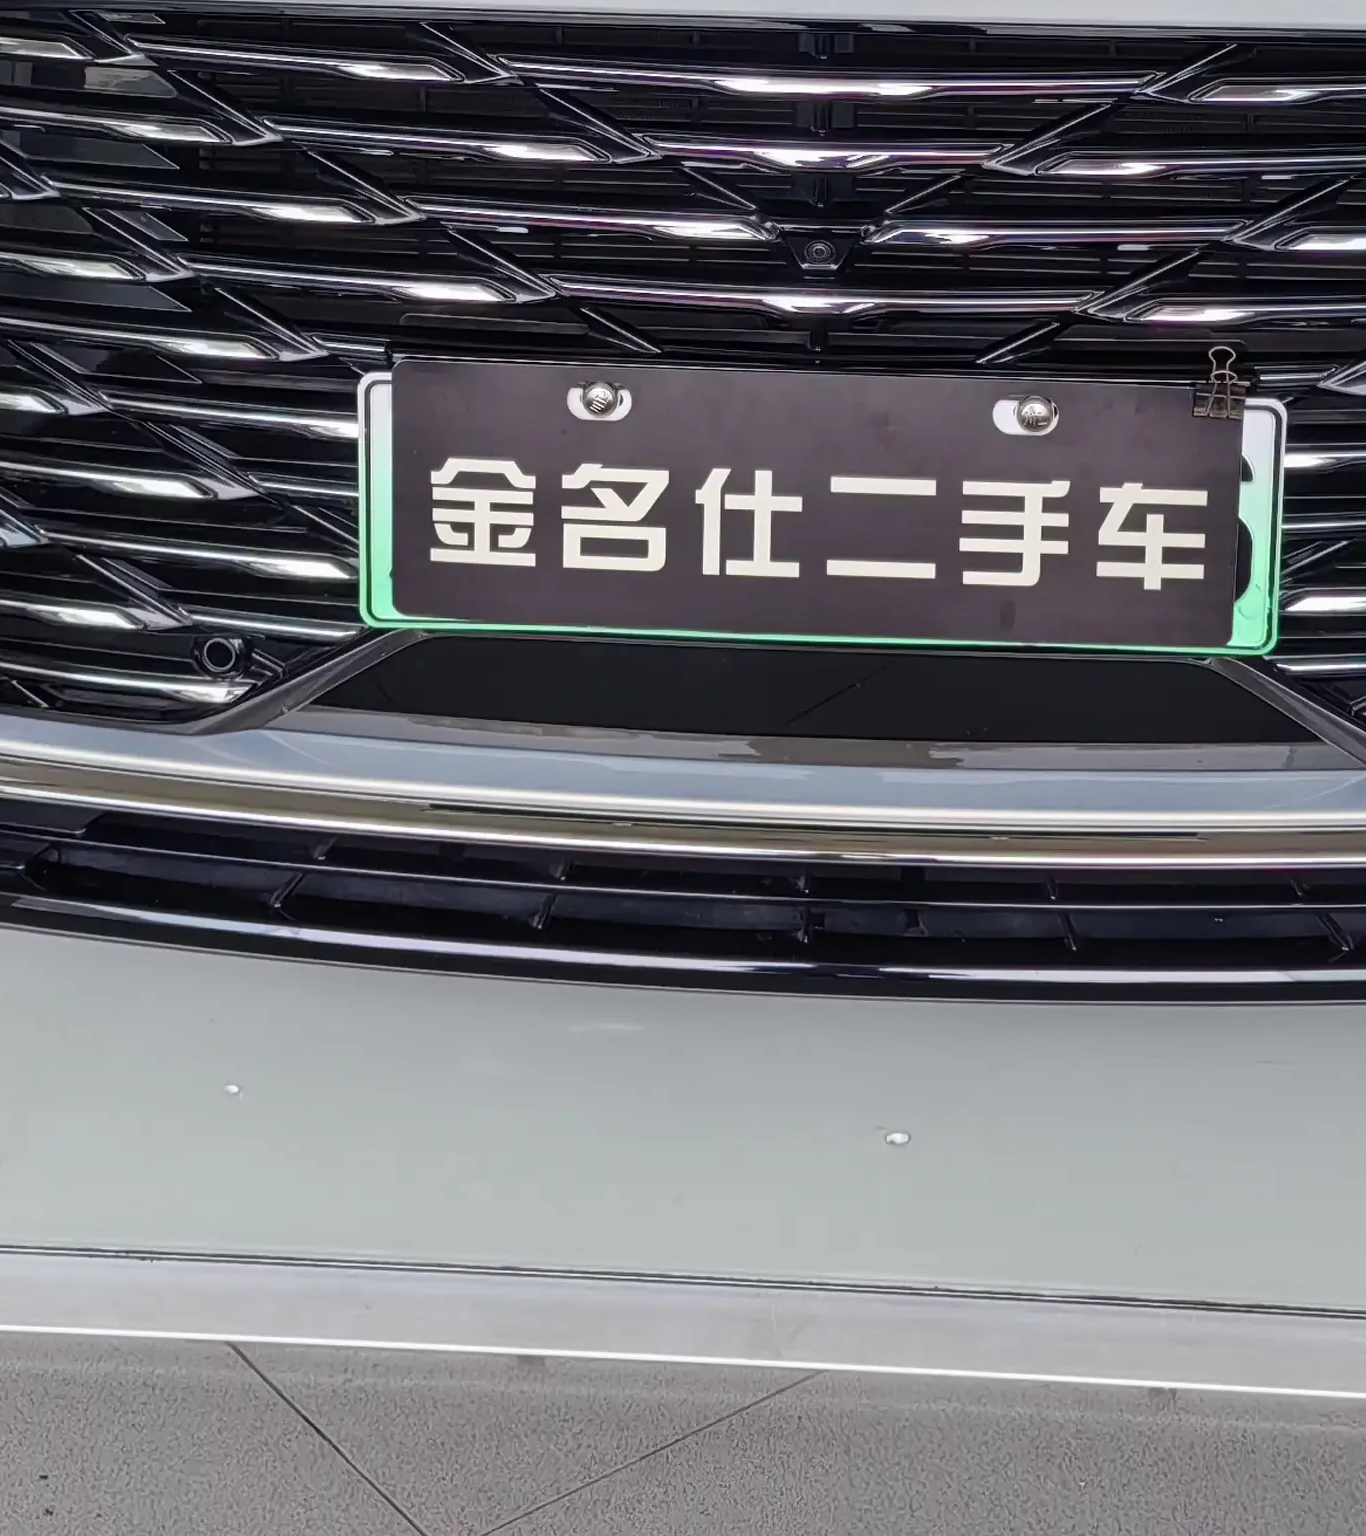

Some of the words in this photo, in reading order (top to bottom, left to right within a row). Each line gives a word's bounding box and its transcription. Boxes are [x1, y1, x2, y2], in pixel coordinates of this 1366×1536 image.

[429, 457, 1209, 592] 金名仕二手车
